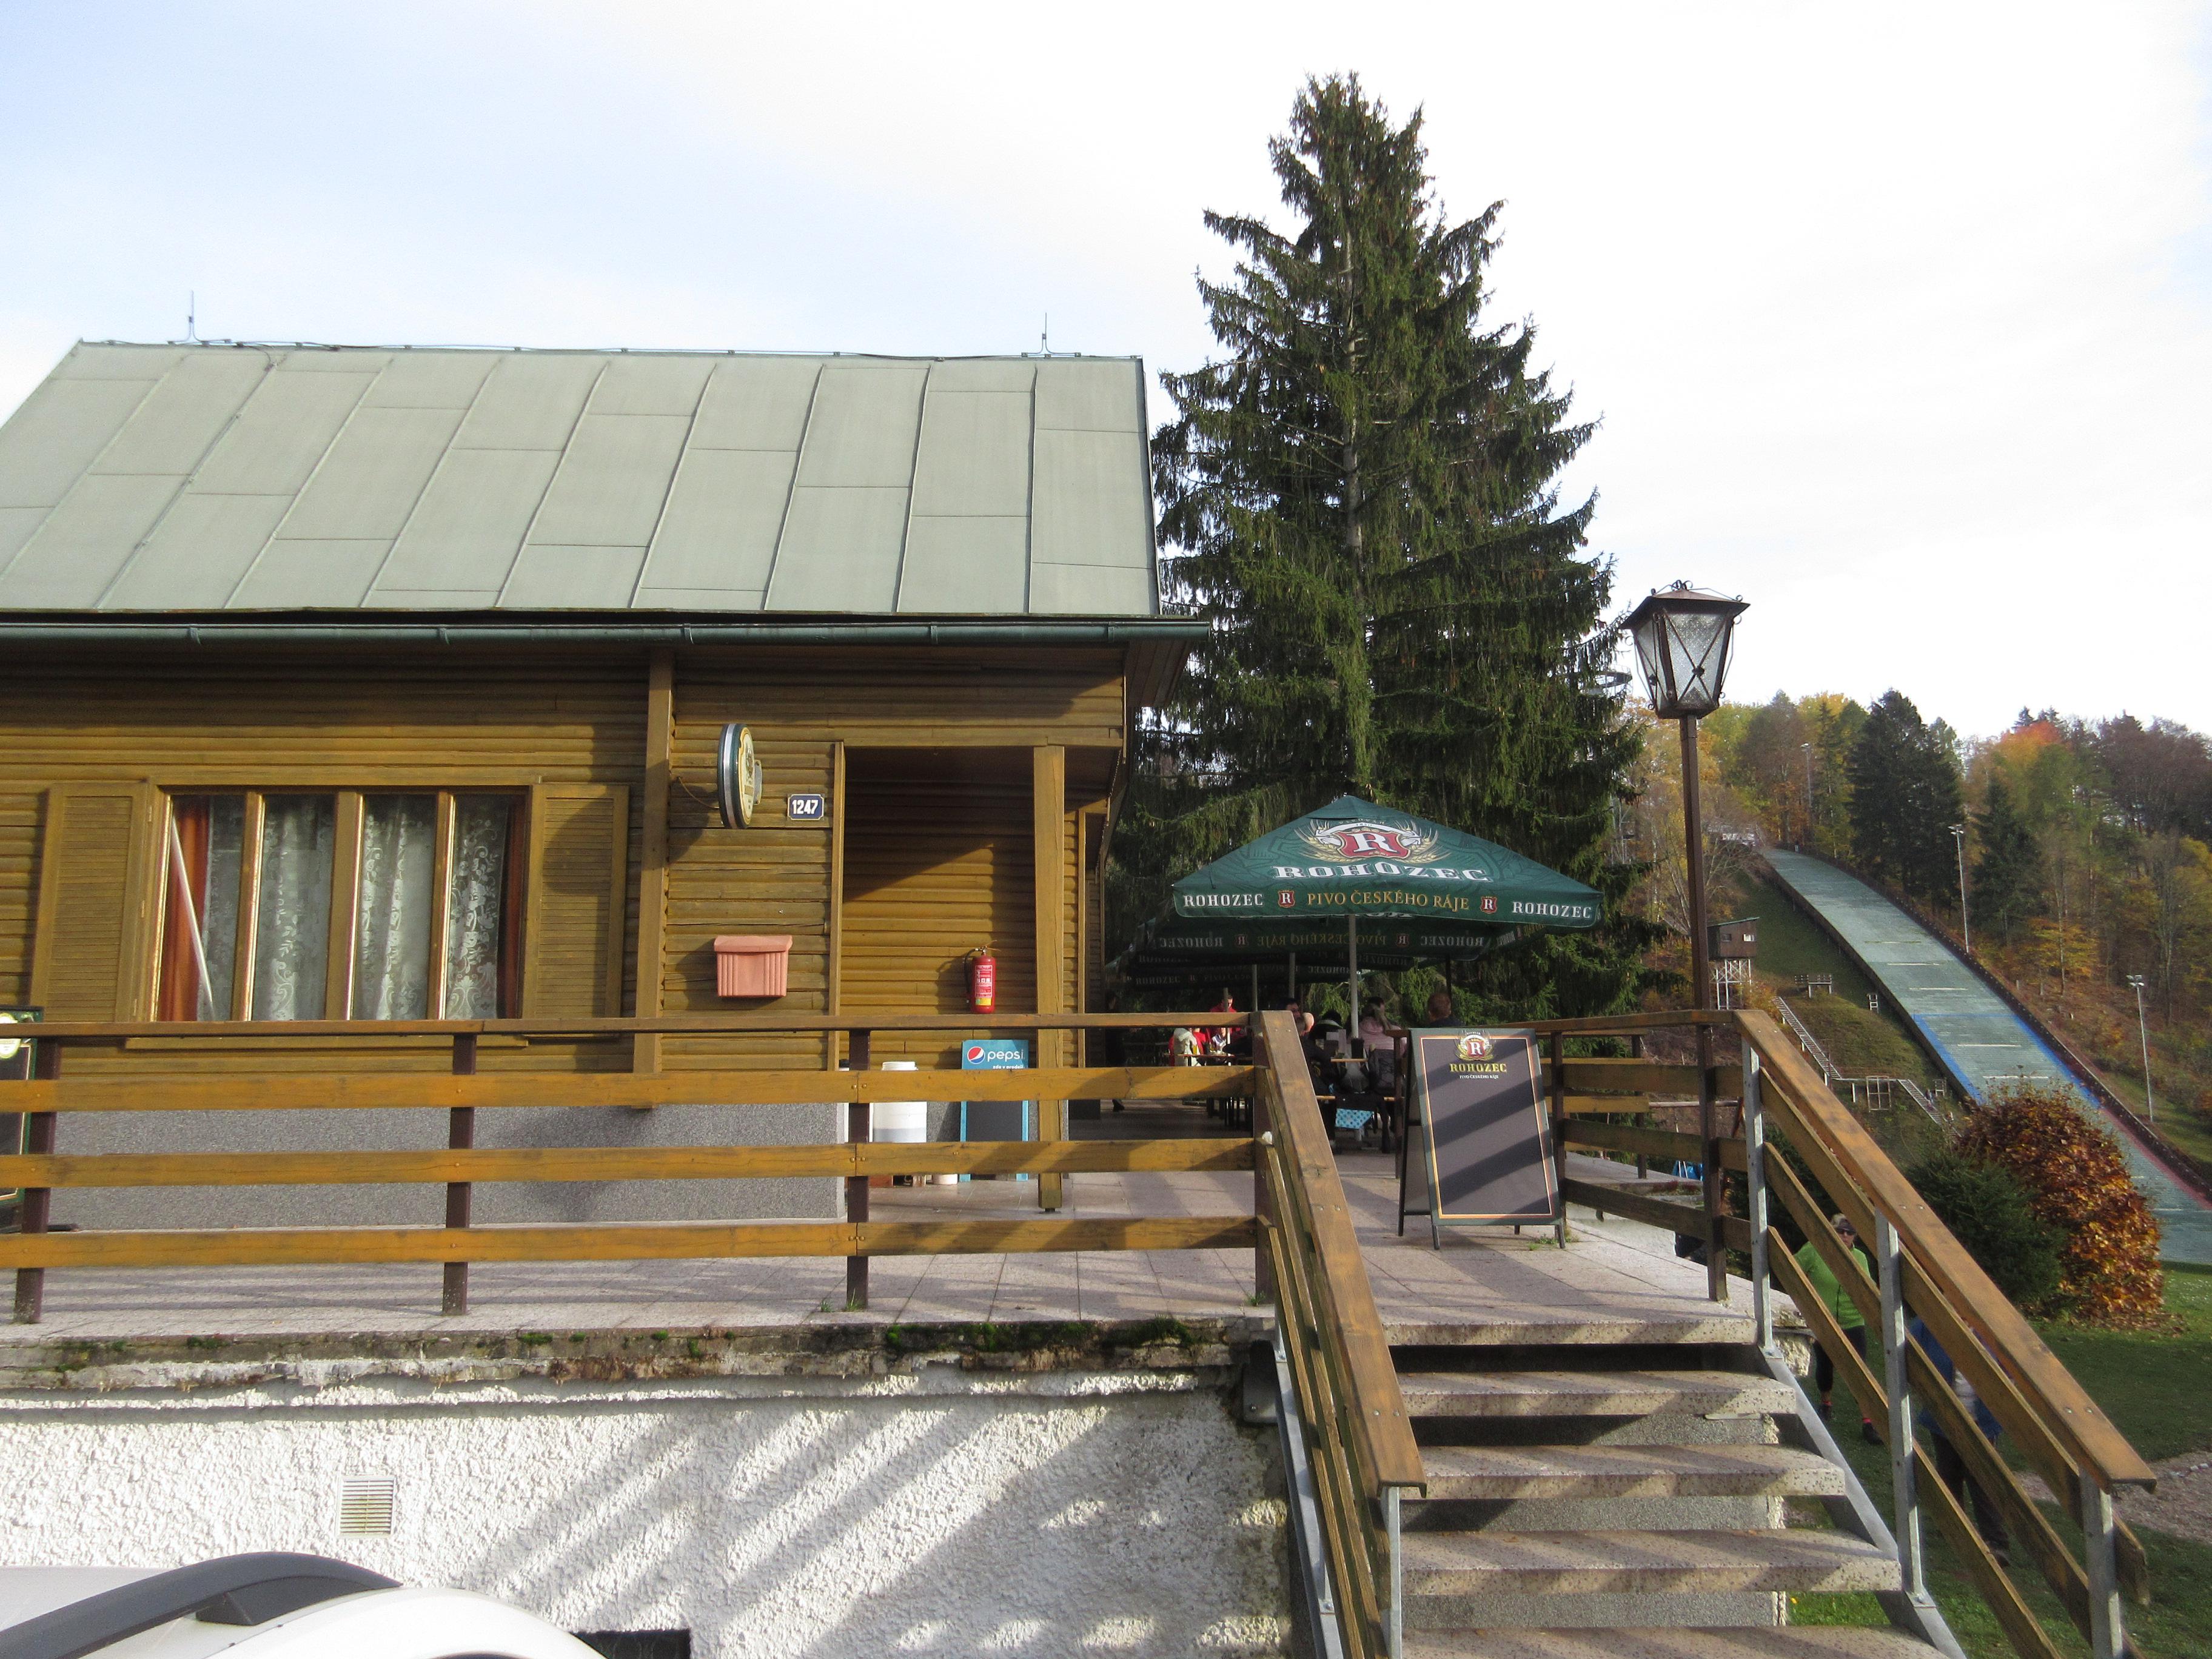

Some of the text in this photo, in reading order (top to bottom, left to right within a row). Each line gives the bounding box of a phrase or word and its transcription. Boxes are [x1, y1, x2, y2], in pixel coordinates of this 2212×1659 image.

[792, 799, 819, 814] 1247
[1346, 833, 1398, 853] R
[1272, 862, 1493, 883] ROHOZEC
[1183, 890, 1592, 919] ROHOZEC R PIVO ČESKÉHO RÁJE R ROHOZEC
[987, 1049, 1024, 1062] pepsi
[1470, 1042, 1483, 1055] R
[1450, 1063, 1507, 1072] ROHOZEC
